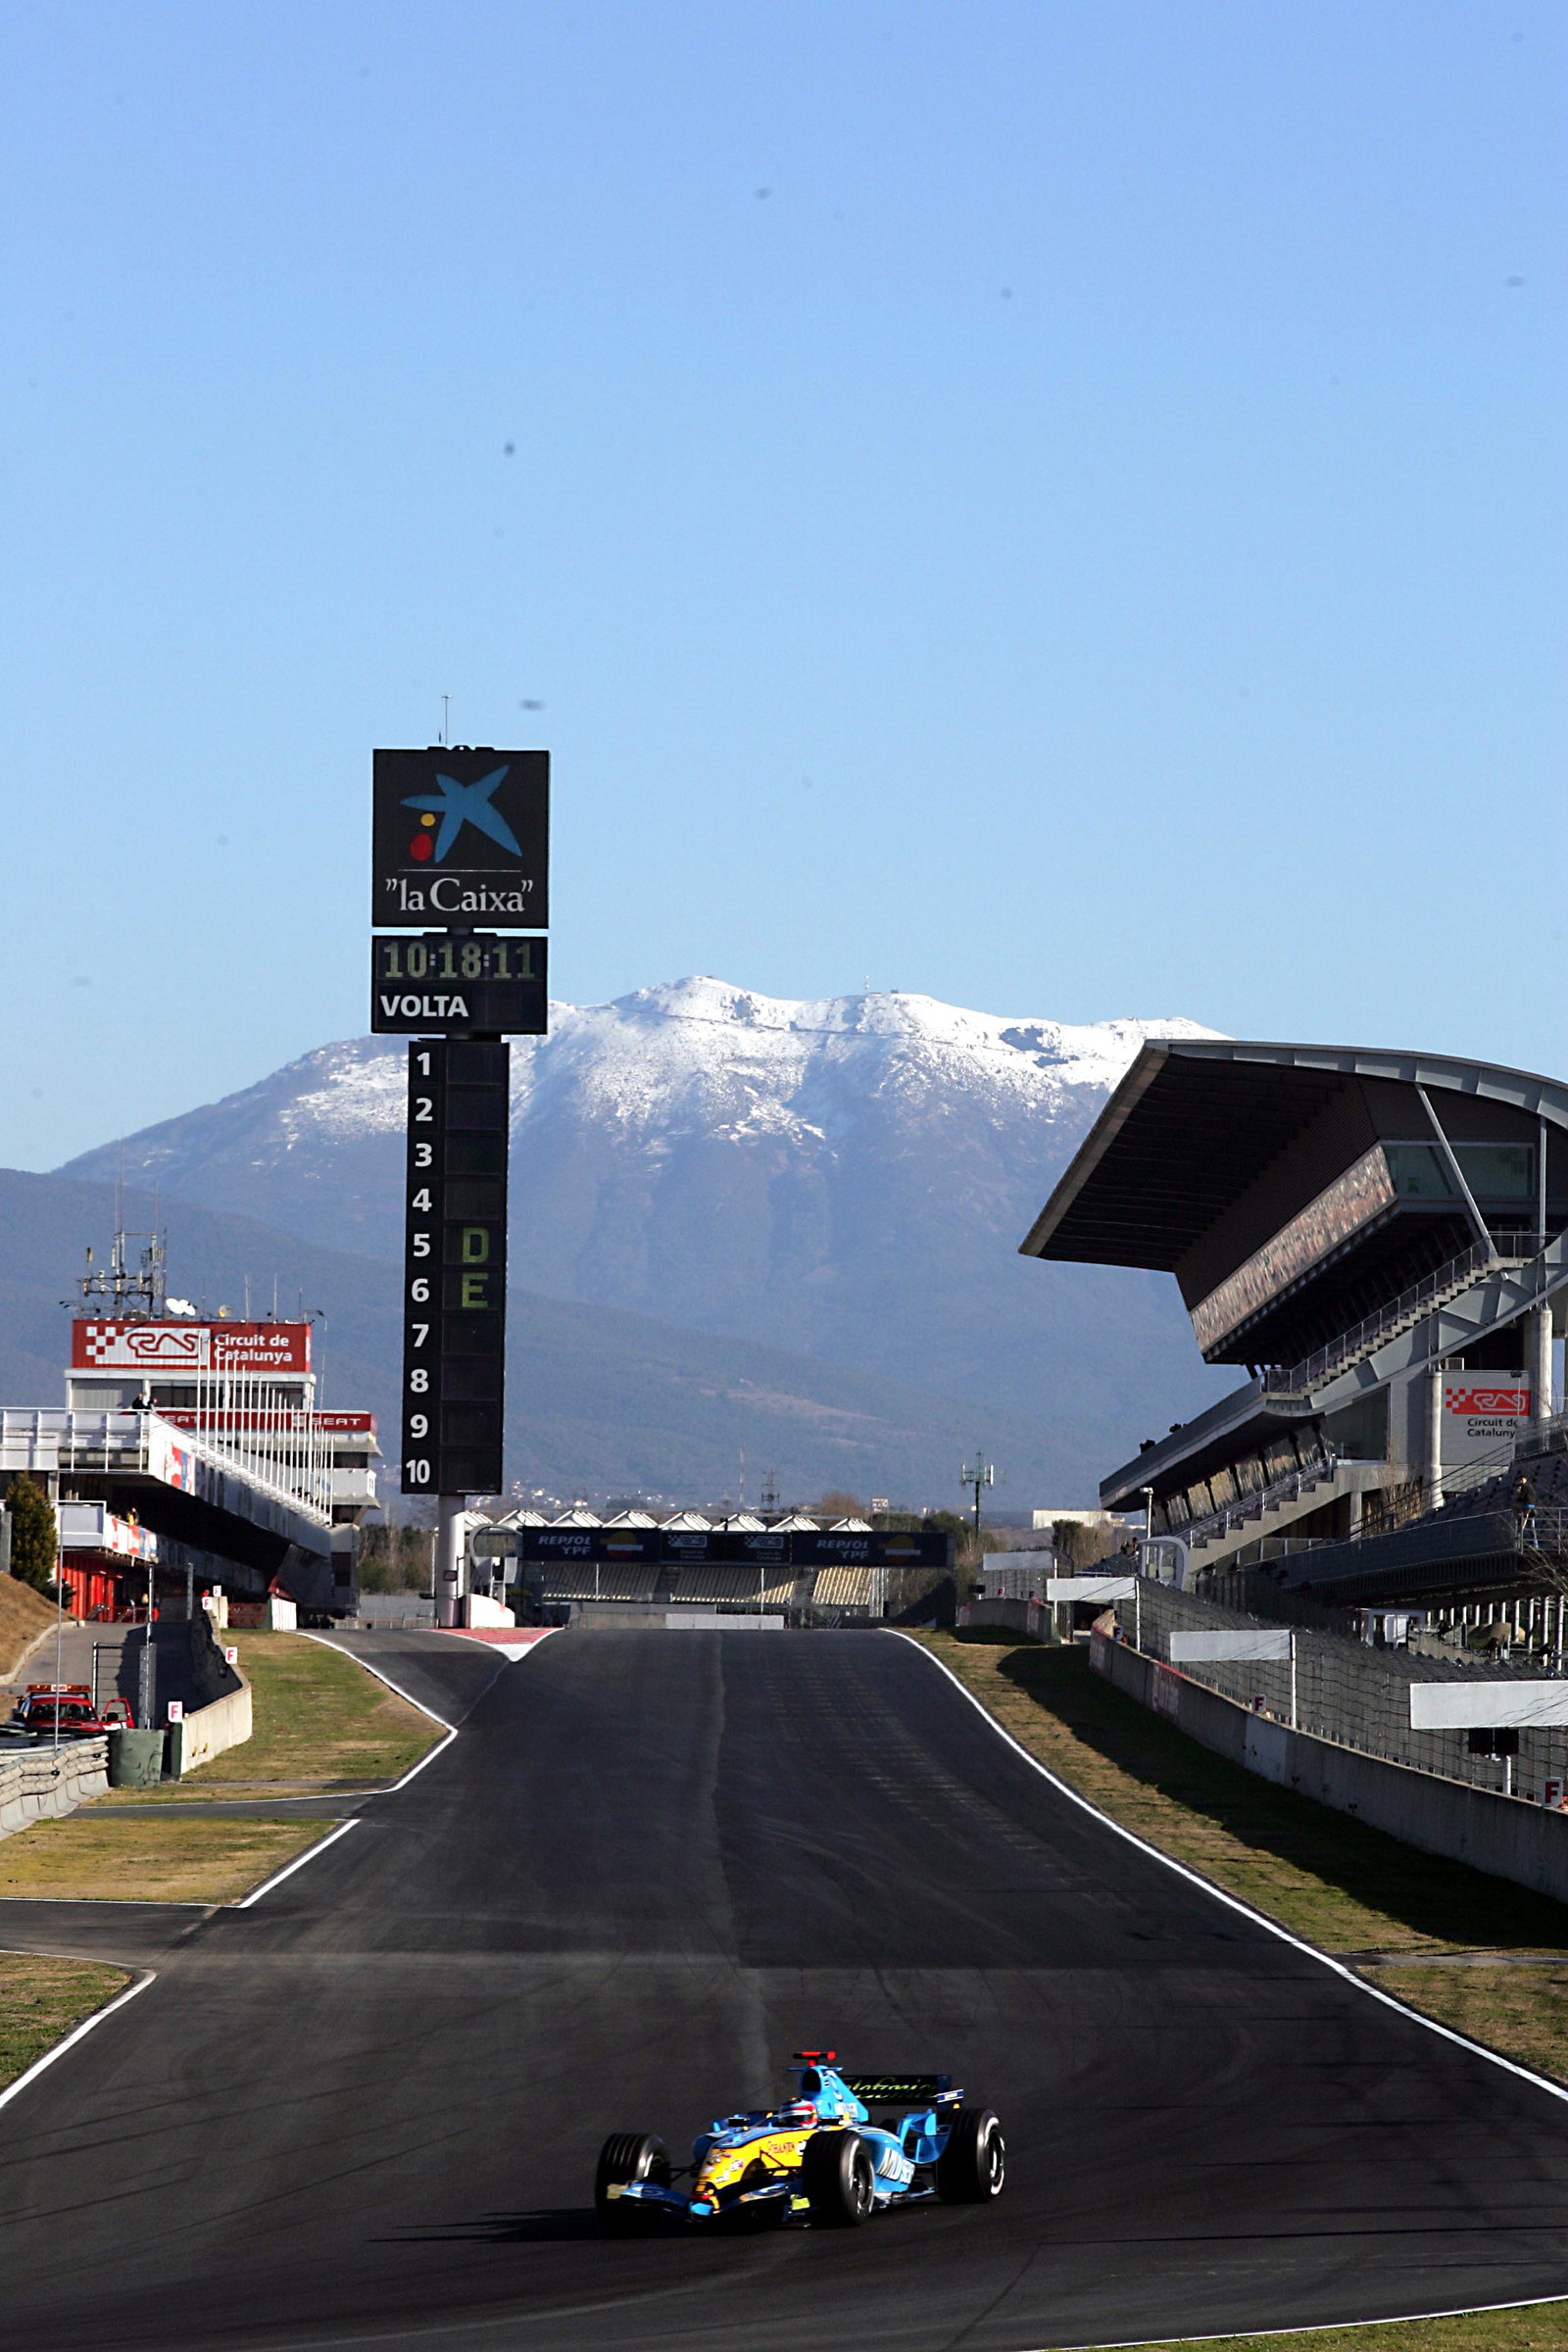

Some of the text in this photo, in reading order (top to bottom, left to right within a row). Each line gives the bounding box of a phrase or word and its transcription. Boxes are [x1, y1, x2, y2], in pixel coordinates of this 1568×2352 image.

[383, 942, 535, 979] 10:18:11
[380, 995, 468, 1017] VOLTA
[416, 1053, 431, 1076] 1
[415, 1098, 433, 1122] 2
[415, 1143, 433, 1167] 3
[412, 1189, 432, 1212] 4
[413, 1234, 430, 1257] 5
[463, 1227, 488, 1263] D
[412, 1279, 429, 1303] 6
[462, 1273, 488, 1308] E
[215, 1334, 289, 1347] Circuit de
[412, 1324, 429, 1348] 7
[214, 1348, 292, 1364] Catalunya
[410, 1369, 429, 1394] 8
[312, 1417, 361, 1426] SEAT
[410, 1414, 428, 1439] 9
[1467, 1418, 1502, 1427] Circuit
[1467, 1429, 1516, 1439] Cataluny
[406, 1459, 430, 1484] 10
[538, 1536, 591, 1545] REPSOL
[562, 1545, 591, 1555] YPF
[816, 1539, 869, 1548] REPSOL
[840, 1549, 869, 1559] YPF
[1113, 1627, 1121, 1639] F
[226, 1650, 234, 1662] F
[171, 1704, 179, 1719] F
[1254, 1696, 1264, 1711] F
[1544, 1781, 1560, 1804] F
